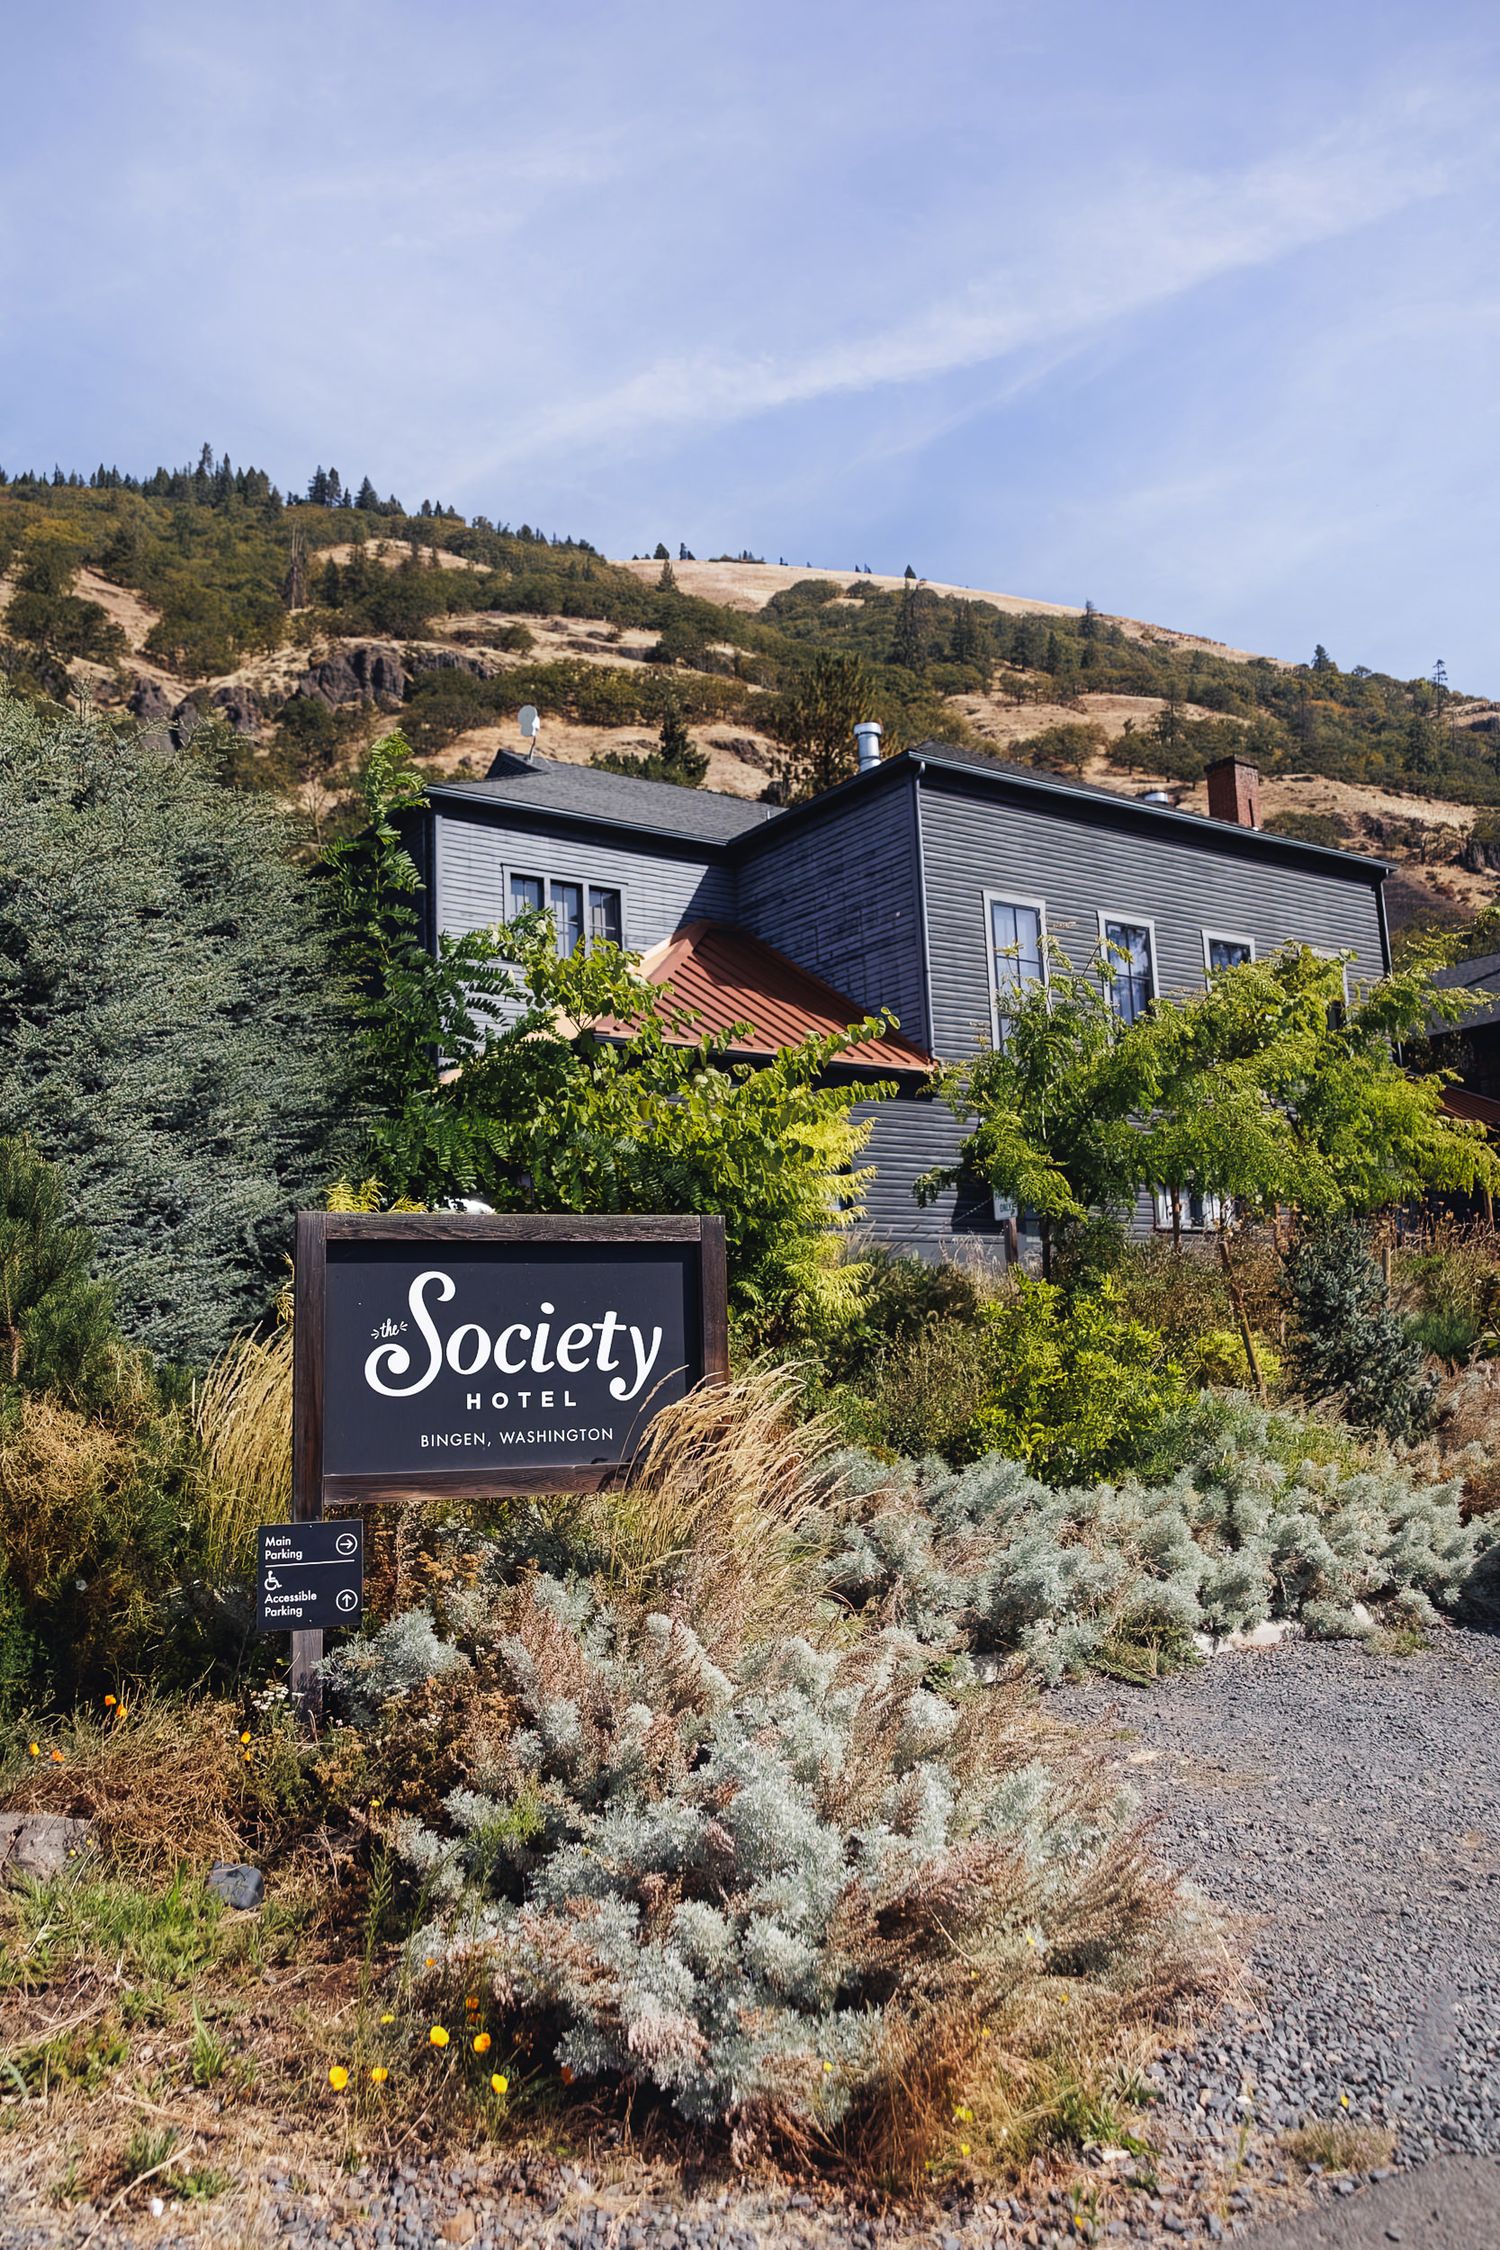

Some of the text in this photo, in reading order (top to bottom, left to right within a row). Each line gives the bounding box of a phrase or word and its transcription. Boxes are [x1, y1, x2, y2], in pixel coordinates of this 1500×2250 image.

[364, 1270, 663, 1402] Society
[379, 1318, 400, 1338] the
[466, 1390, 577, 1410] HOTEL
[420, 1427, 613, 1448] BINGEN, WASHINGTON
[264, 1535, 292, 1547] Main
[264, 1548, 303, 1561] Parking
[264, 1589, 318, 1605] Accessible
[264, 1604, 303, 1618] Parking
